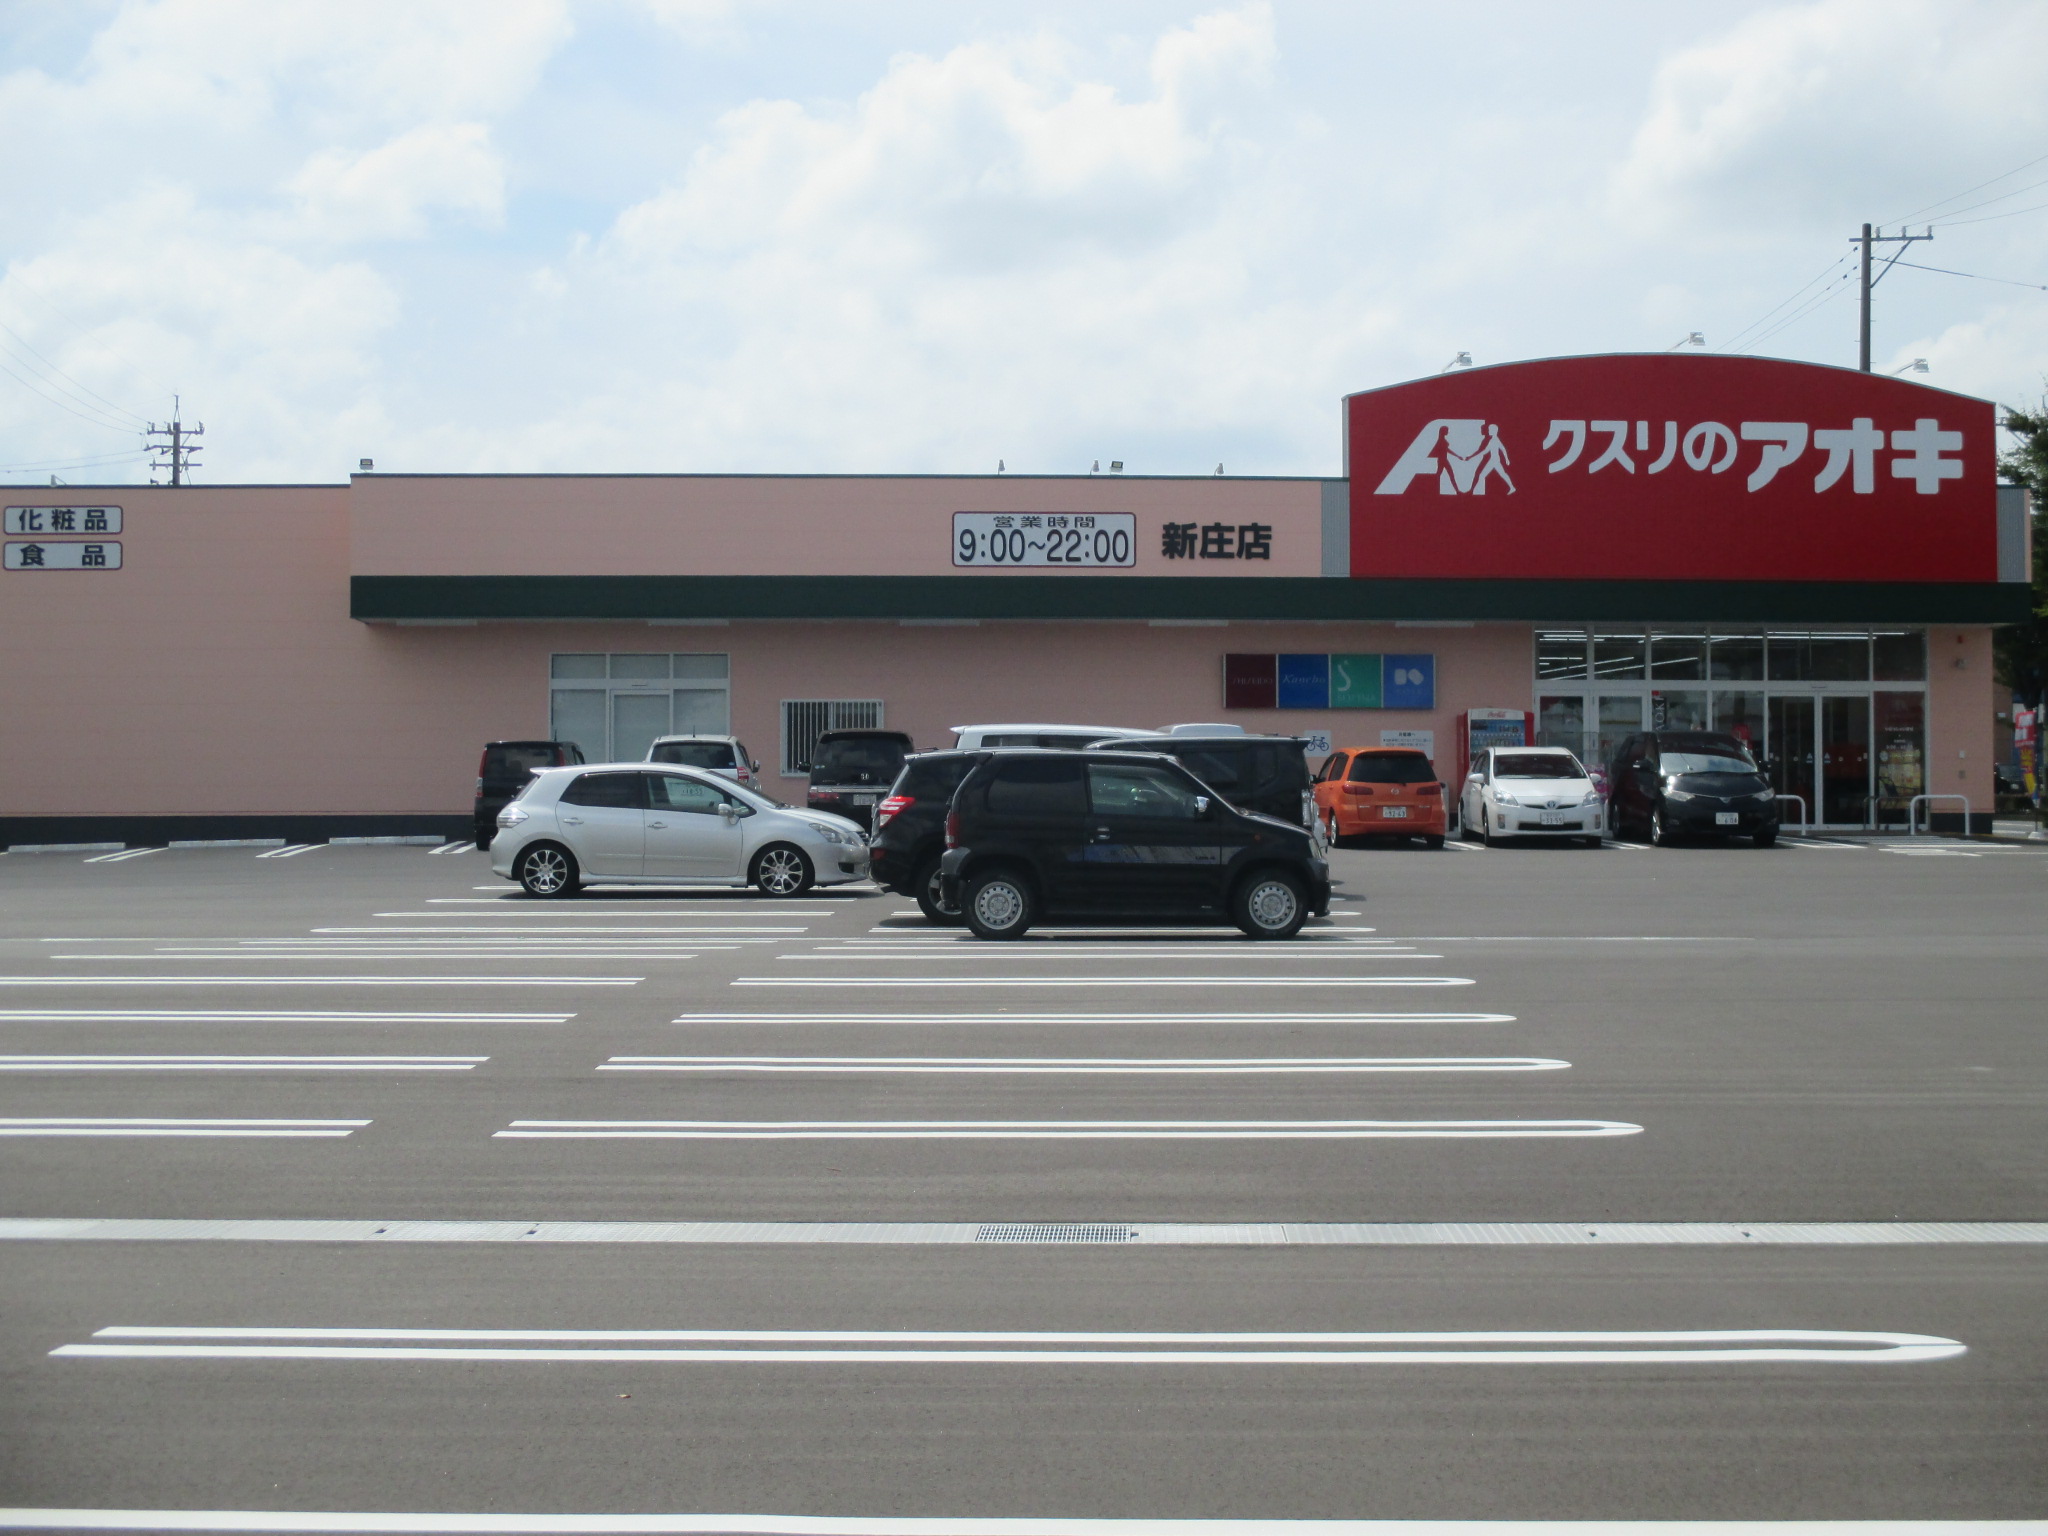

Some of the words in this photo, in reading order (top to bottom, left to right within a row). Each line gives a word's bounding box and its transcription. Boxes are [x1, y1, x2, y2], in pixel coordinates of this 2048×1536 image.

[1542, 417, 1964, 495] クスリのアオキ
[19, 508, 107, 531] 化粧品
[993, 515, 1096, 529] 営業時間
[1161, 522, 1272, 560] 新庄店
[20, 544, 106, 566] 食品
